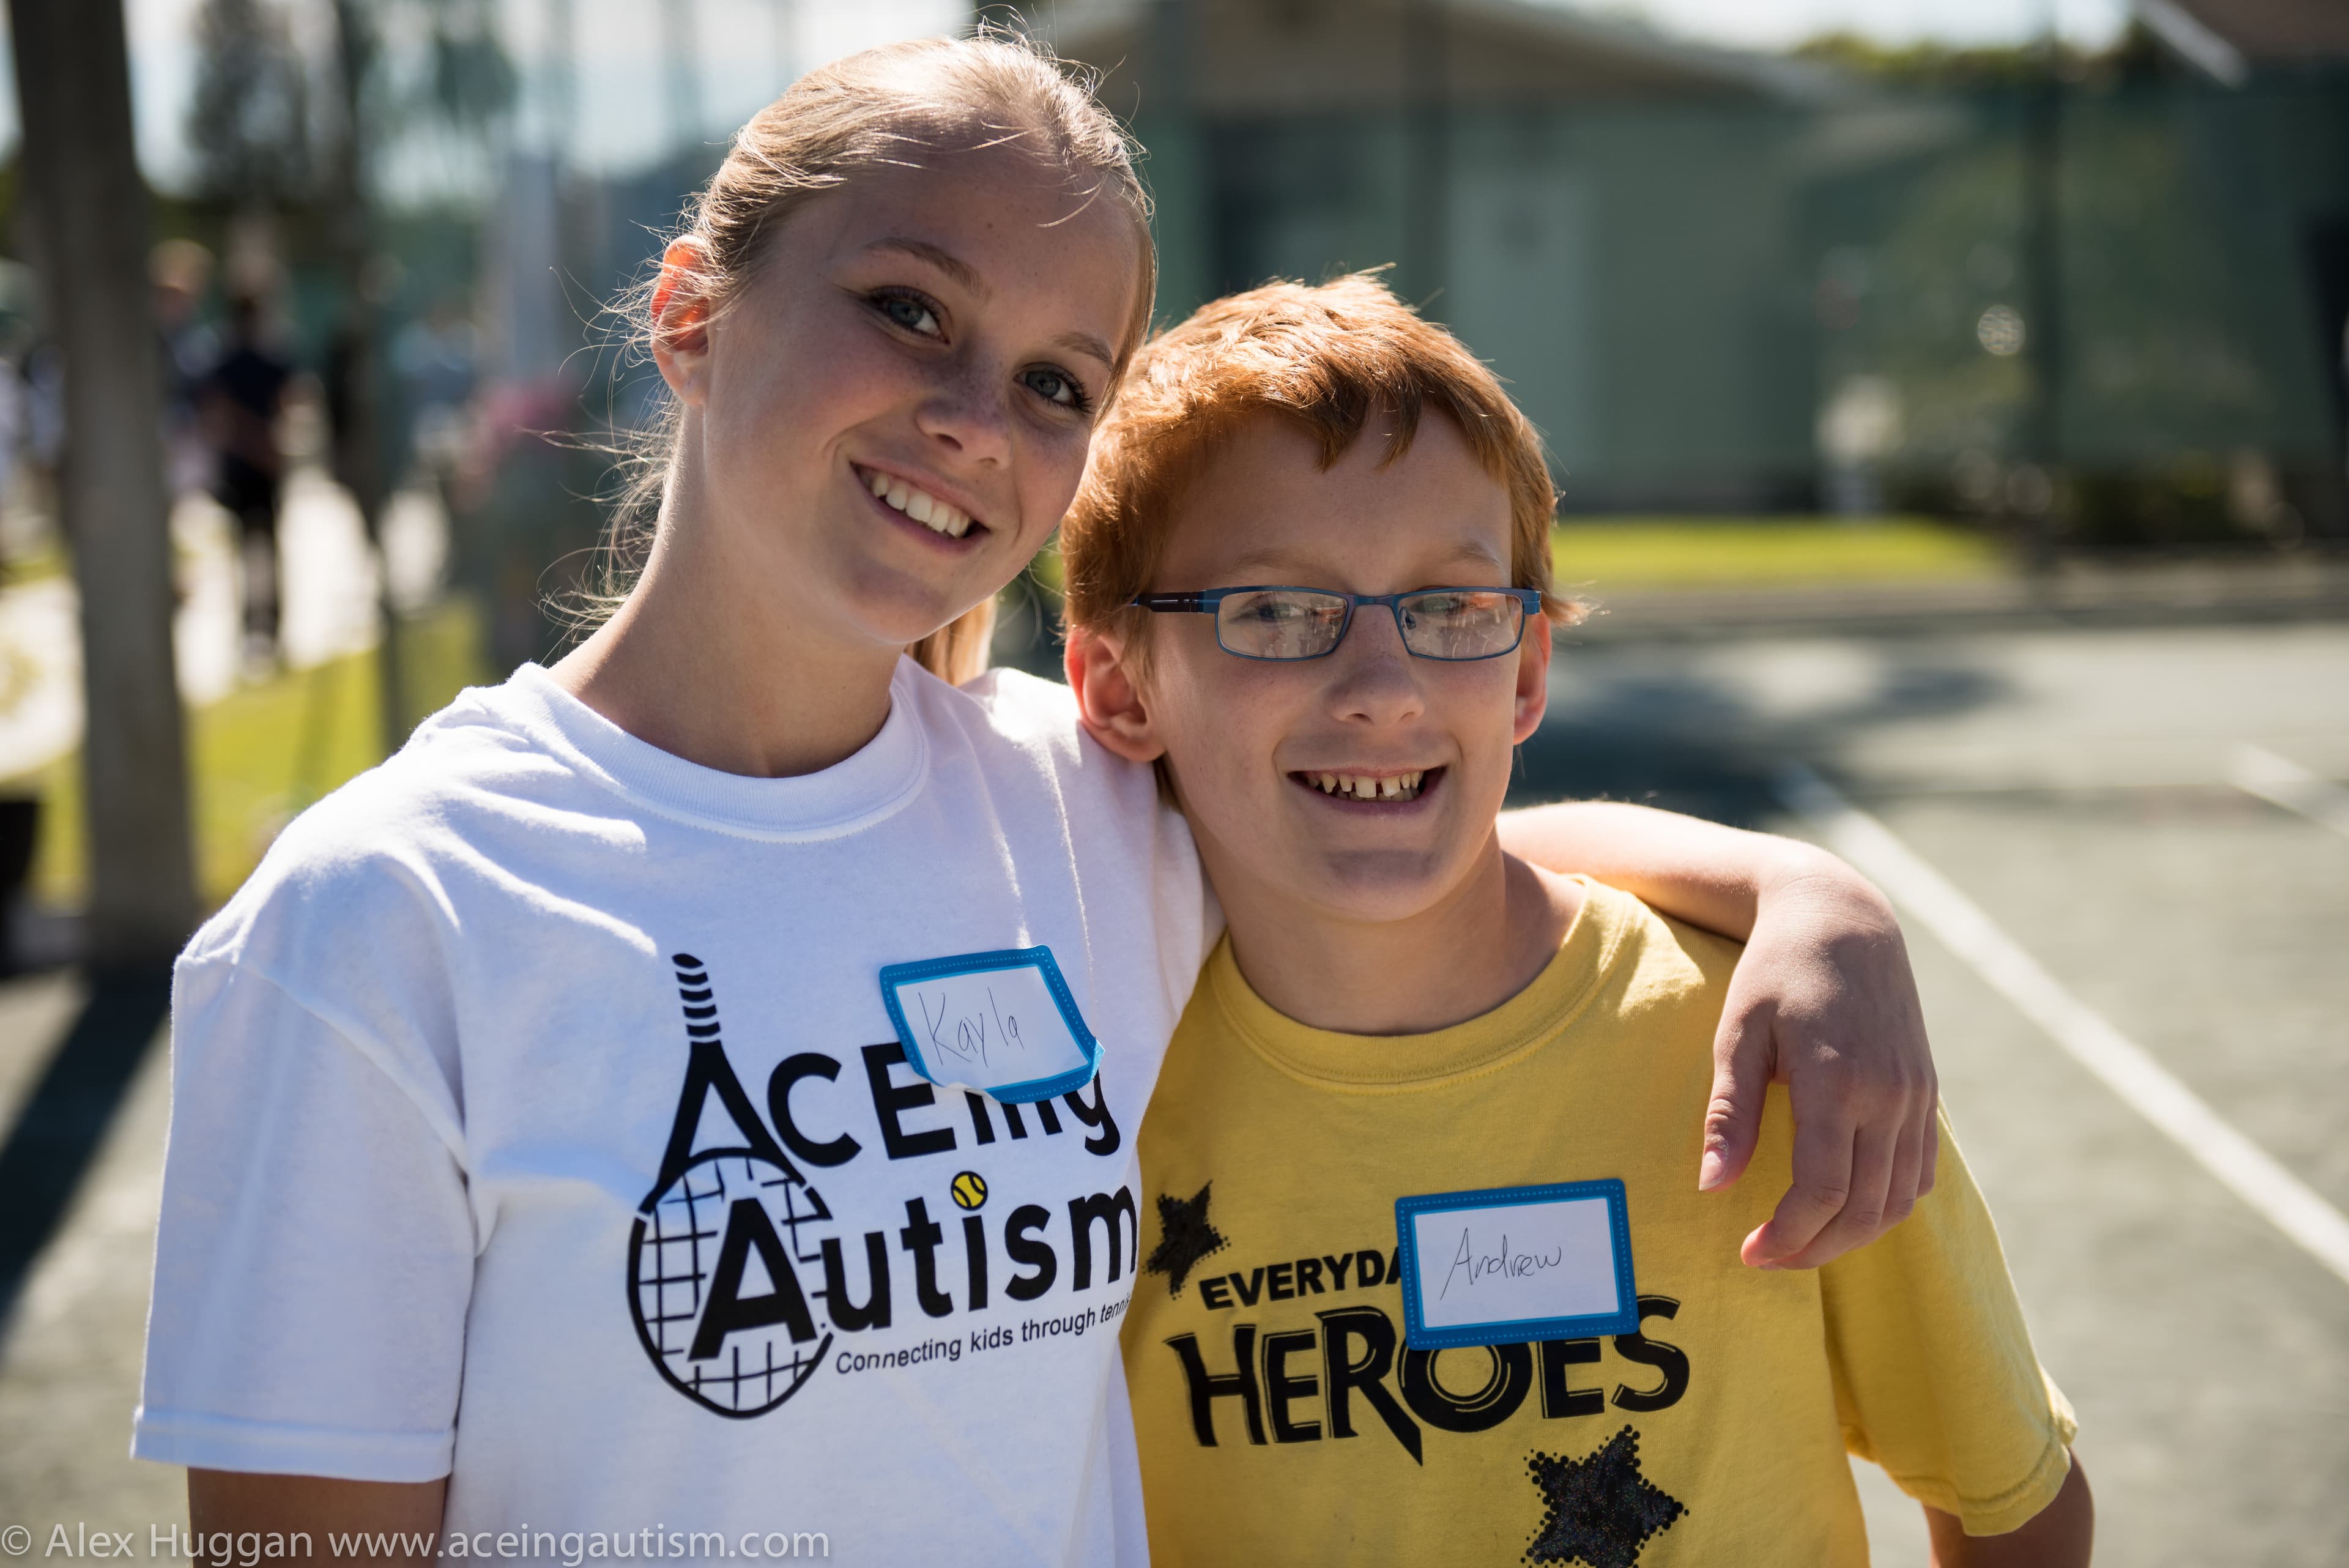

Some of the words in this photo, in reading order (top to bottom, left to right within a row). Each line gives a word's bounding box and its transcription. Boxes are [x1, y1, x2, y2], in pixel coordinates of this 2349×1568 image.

[918, 986, 1025, 1068] Kayla
[687, 1170, 1138, 1362] Autism
[1439, 1227, 1562, 1301] Andrew
[836, 1337, 962, 1375] Connecting
[970, 1326, 1014, 1353] kids
[1022, 1307, 1096, 1342] through
[1162, 1295, 1690, 1466] HEROES
